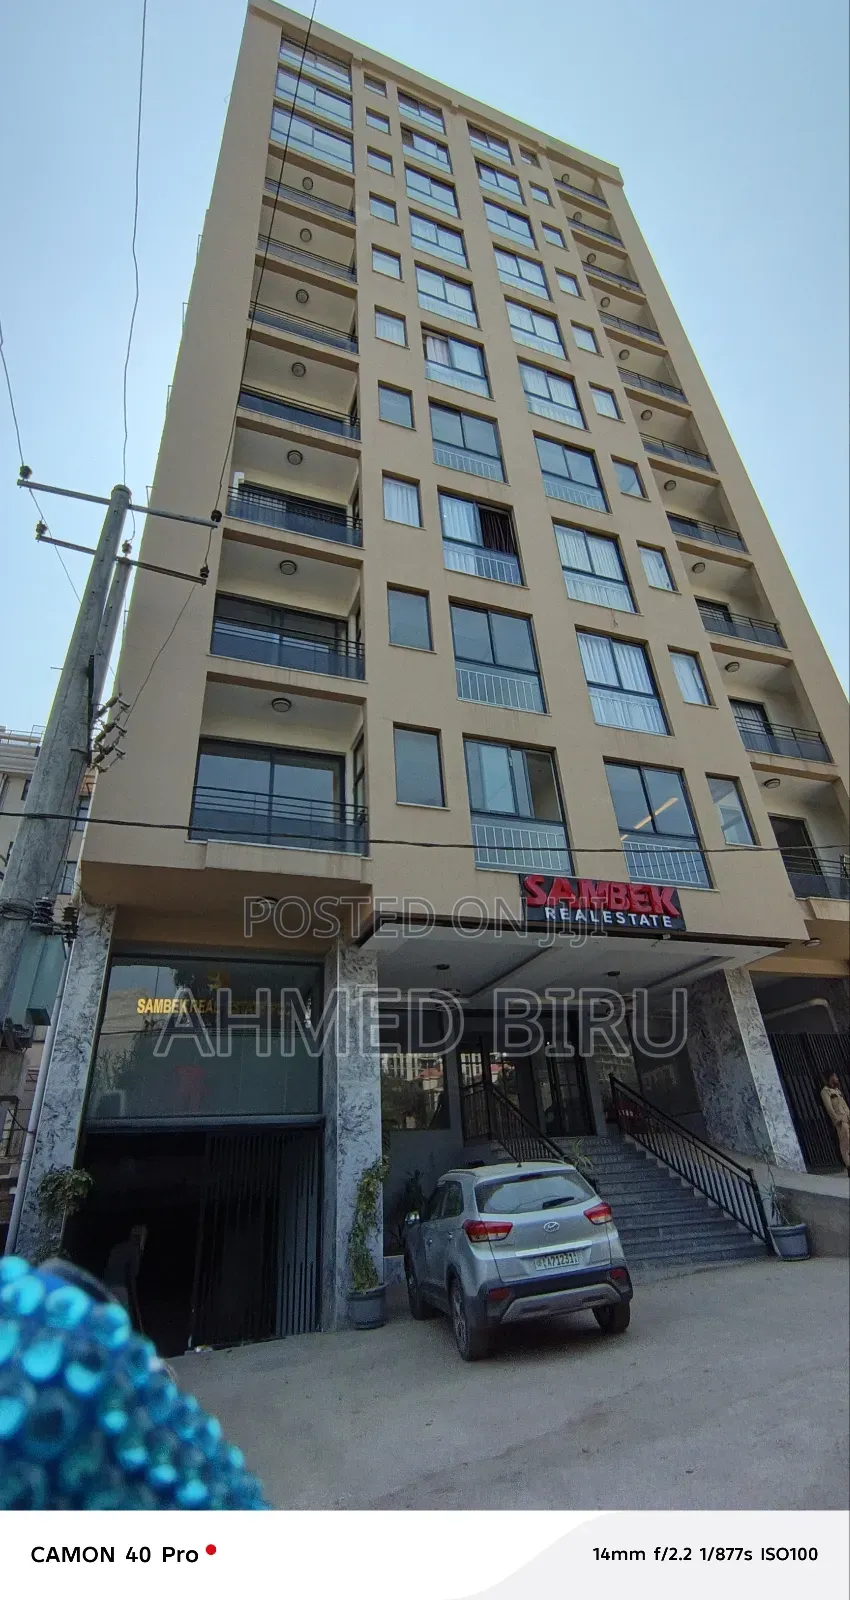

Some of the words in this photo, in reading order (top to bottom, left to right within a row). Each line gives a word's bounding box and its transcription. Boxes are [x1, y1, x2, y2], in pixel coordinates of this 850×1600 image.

[523, 875, 681, 918] SAMBEK
[545, 907, 672, 928] REALESTATE
[136, 998, 188, 1015] SAMBEK
